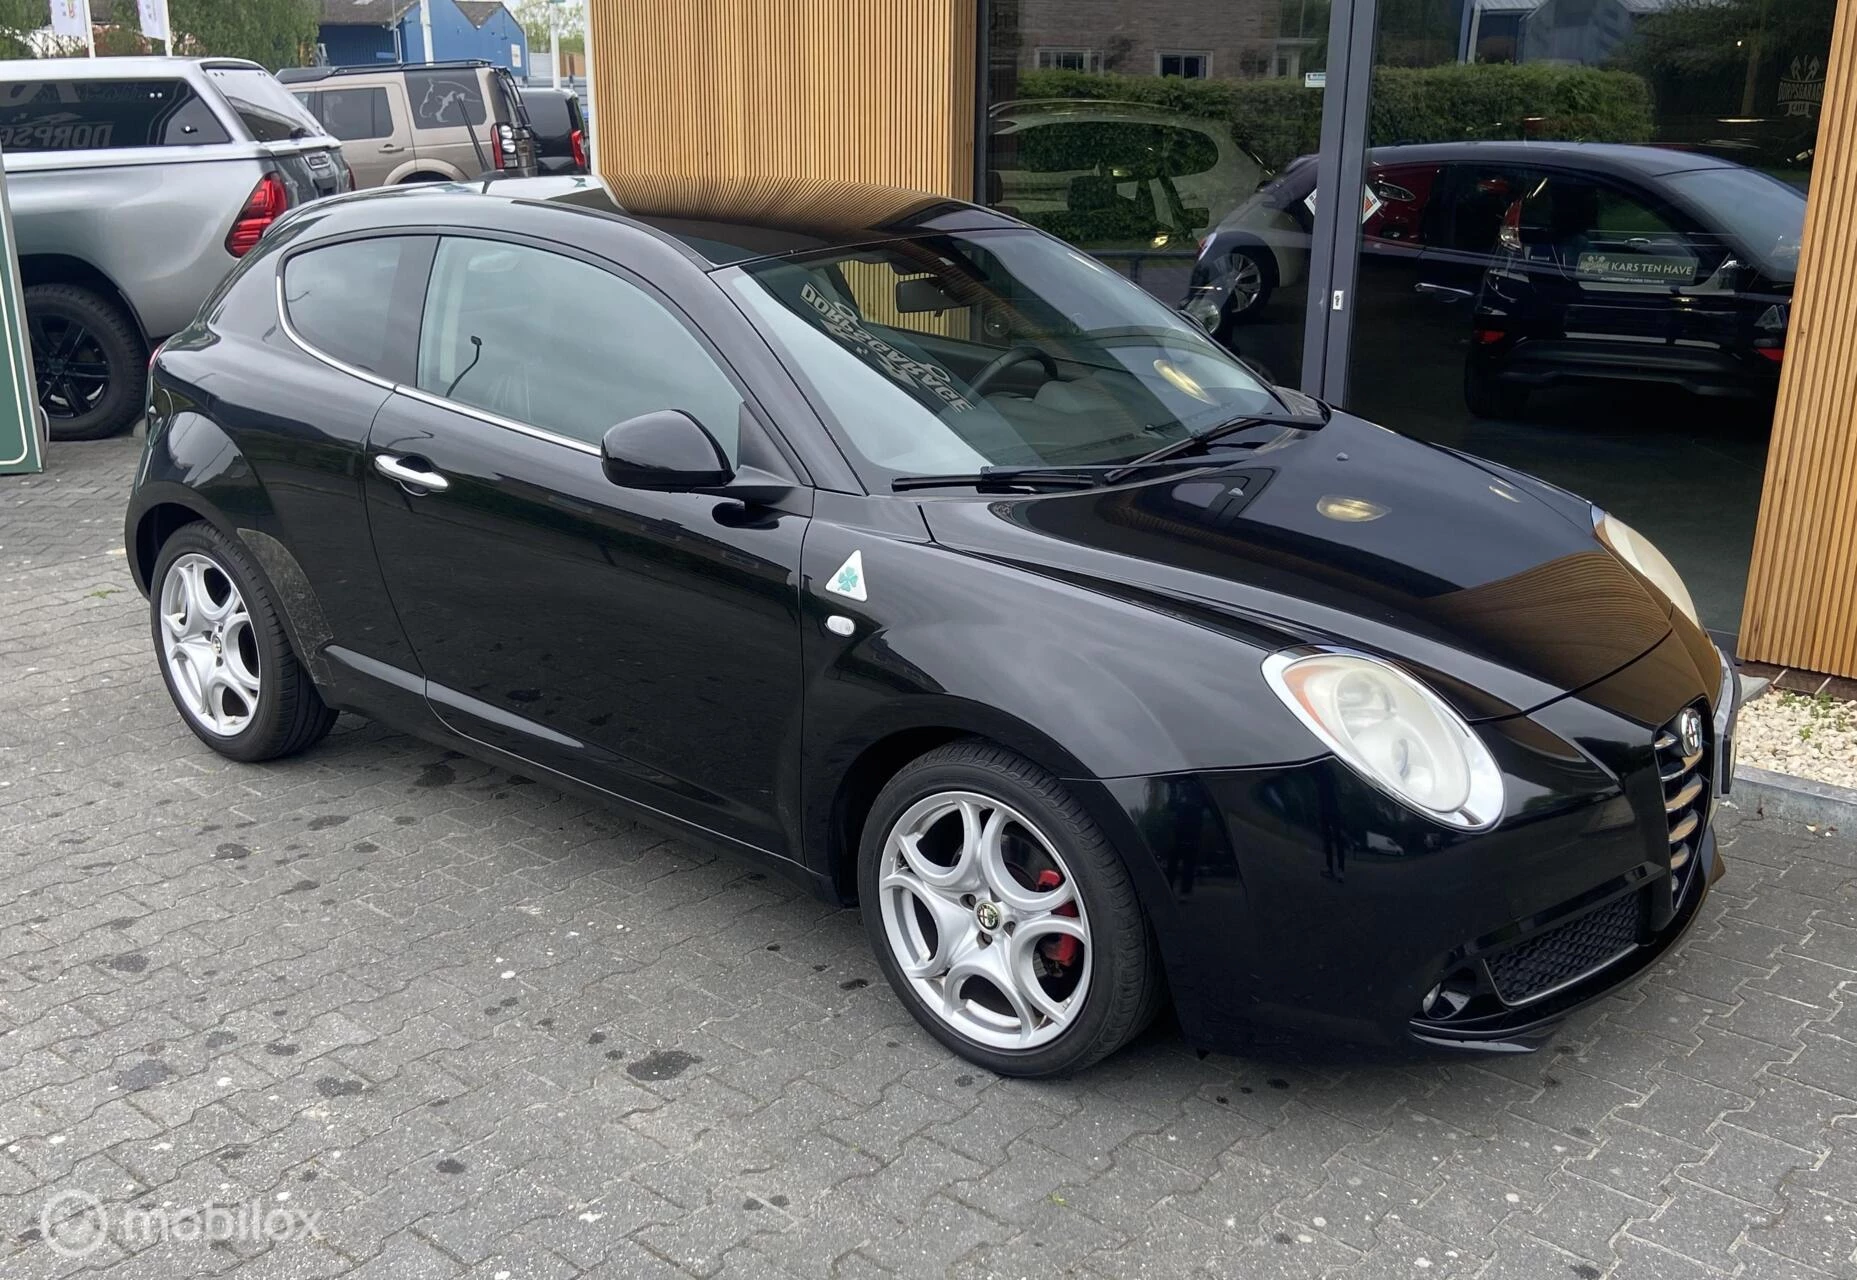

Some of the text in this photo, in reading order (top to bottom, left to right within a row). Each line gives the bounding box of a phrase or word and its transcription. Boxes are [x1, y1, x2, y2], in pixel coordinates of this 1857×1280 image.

[1611, 261, 1639, 271] KARS
[1641, 263, 1660, 273] TEN
[1663, 264, 1693, 275] HAVE
